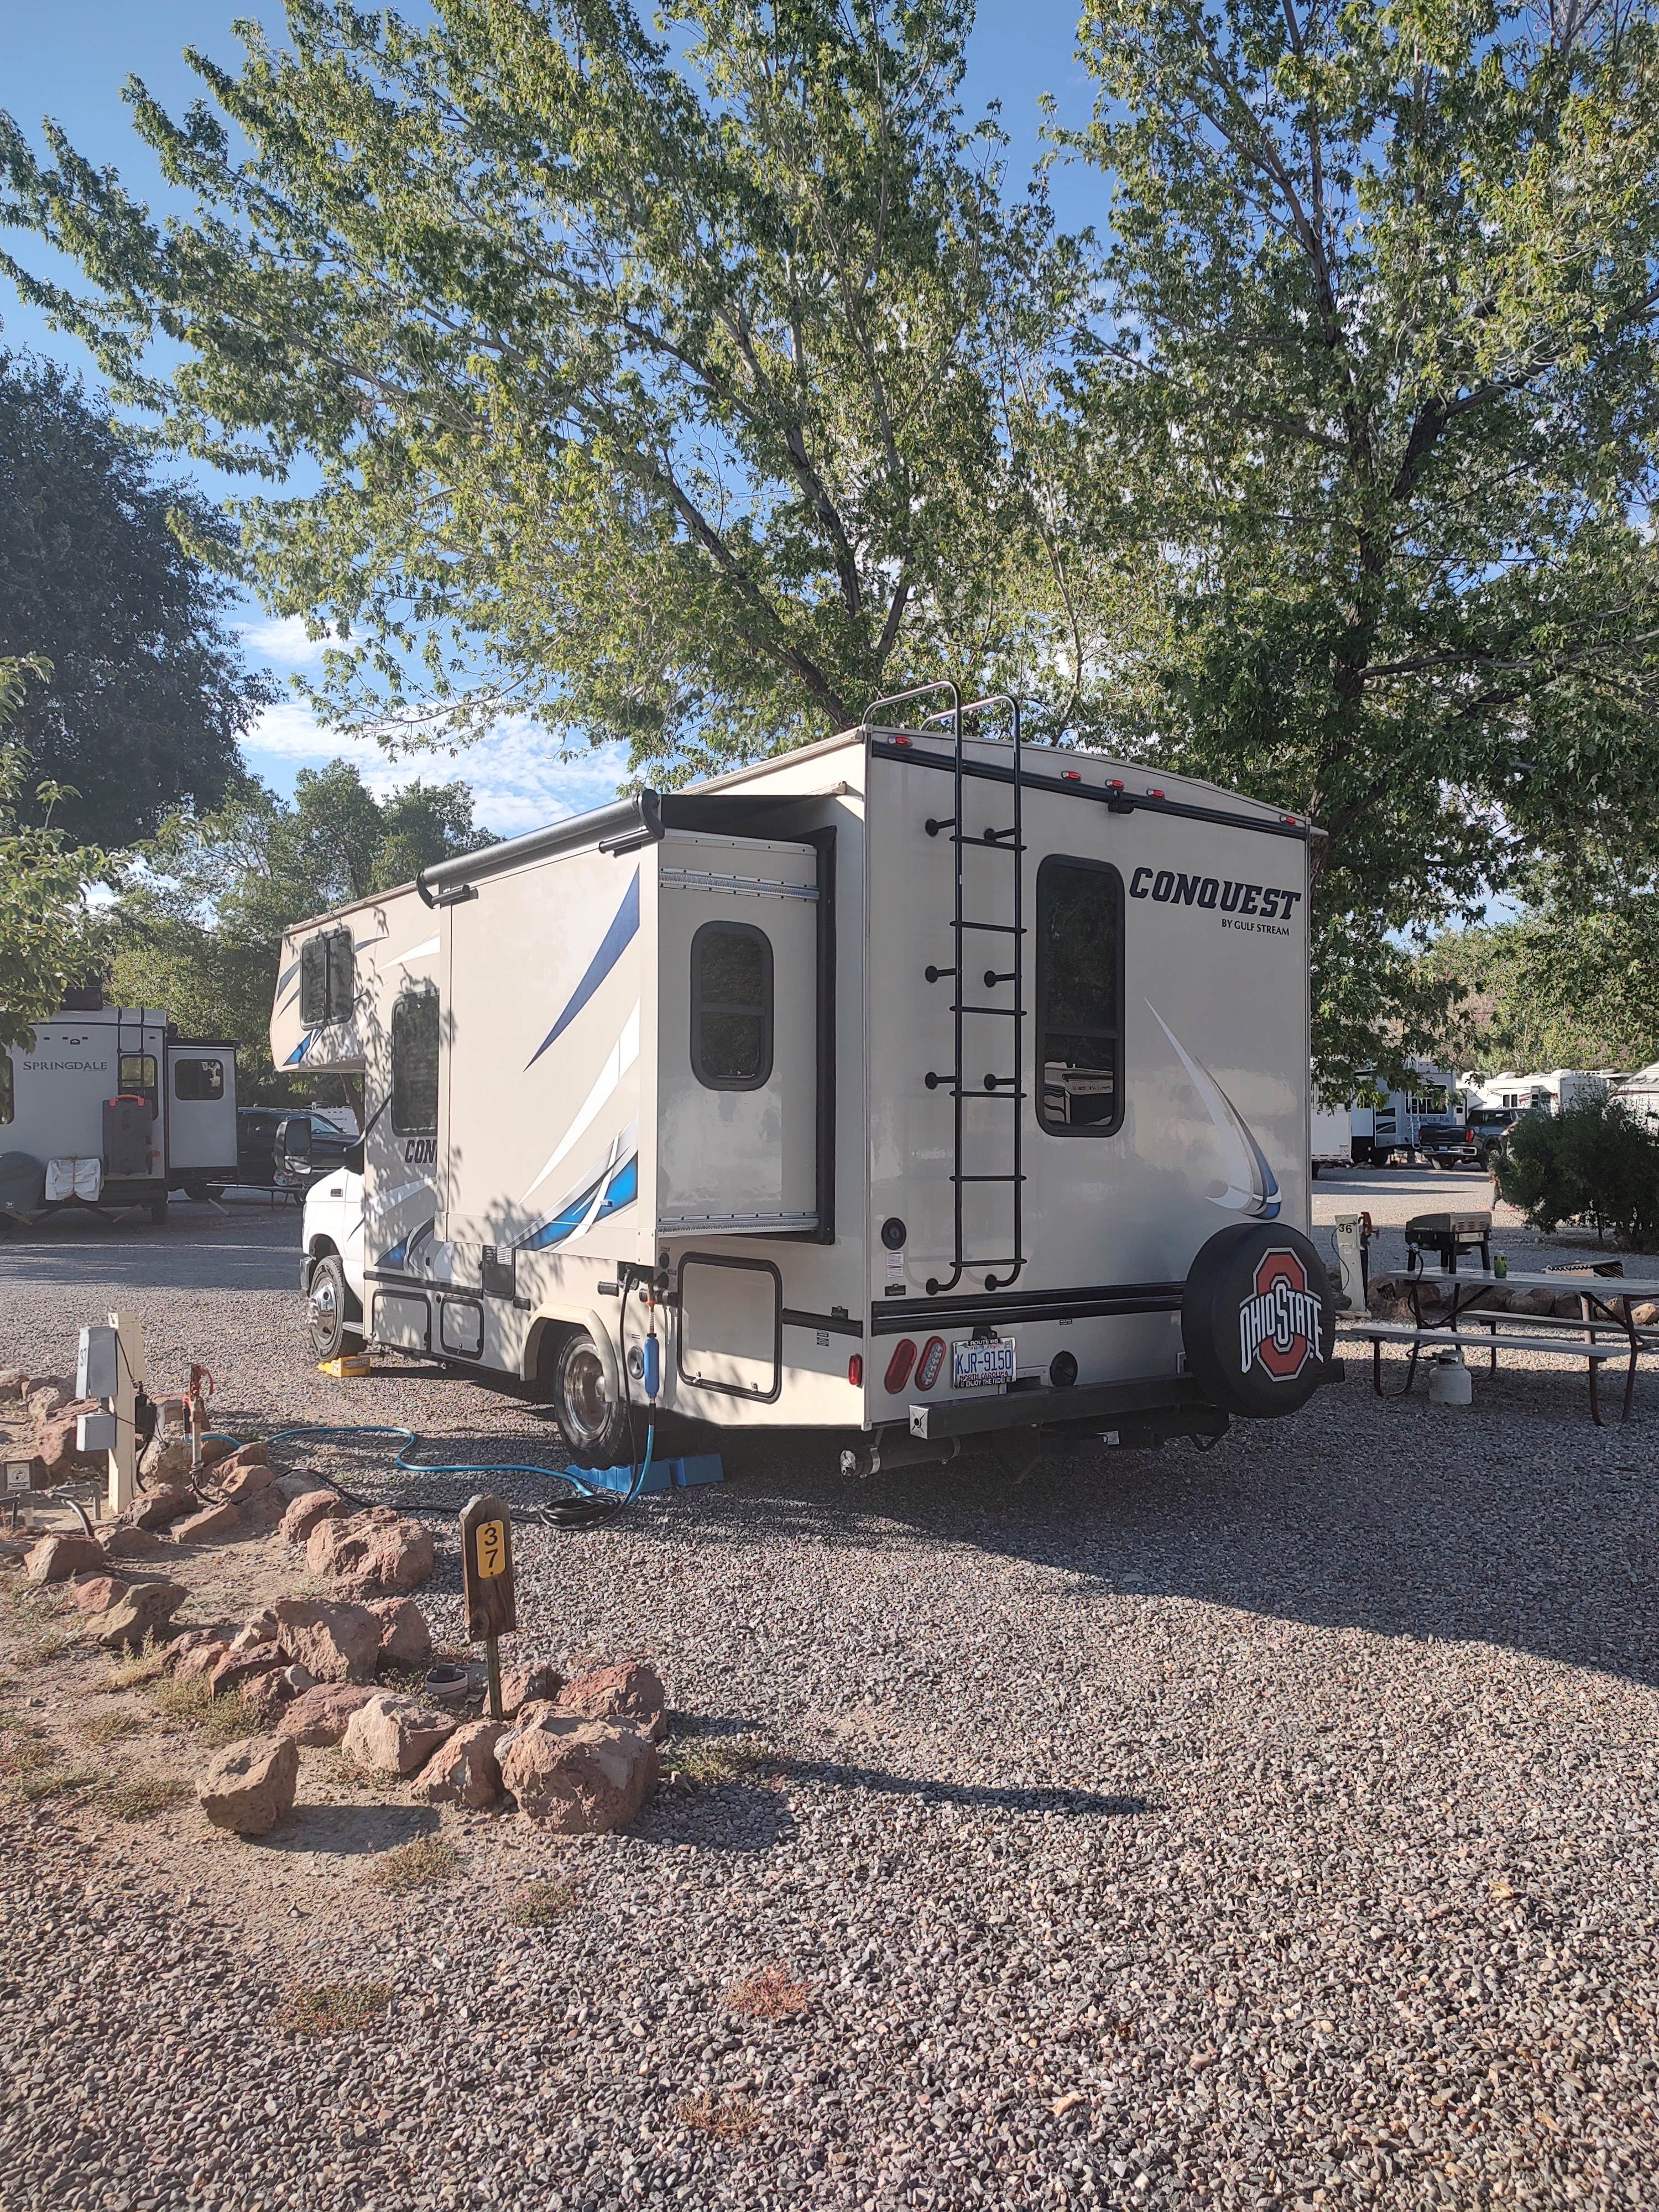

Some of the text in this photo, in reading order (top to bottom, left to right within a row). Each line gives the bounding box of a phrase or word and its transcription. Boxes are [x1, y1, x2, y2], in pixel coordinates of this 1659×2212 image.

[1129, 867, 1302, 920] CONQUEST
[1222, 919, 1290, 936] BY GULF STREAM
[23, 1061, 108, 1071] SPRINGDALE
[405, 1139, 437, 1164] CON
[1339, 1223, 1353, 1234] 36
[957, 1350, 1011, 1375] KJR-9150
[959, 1371, 1009, 1381] NORTH CAROLINA
